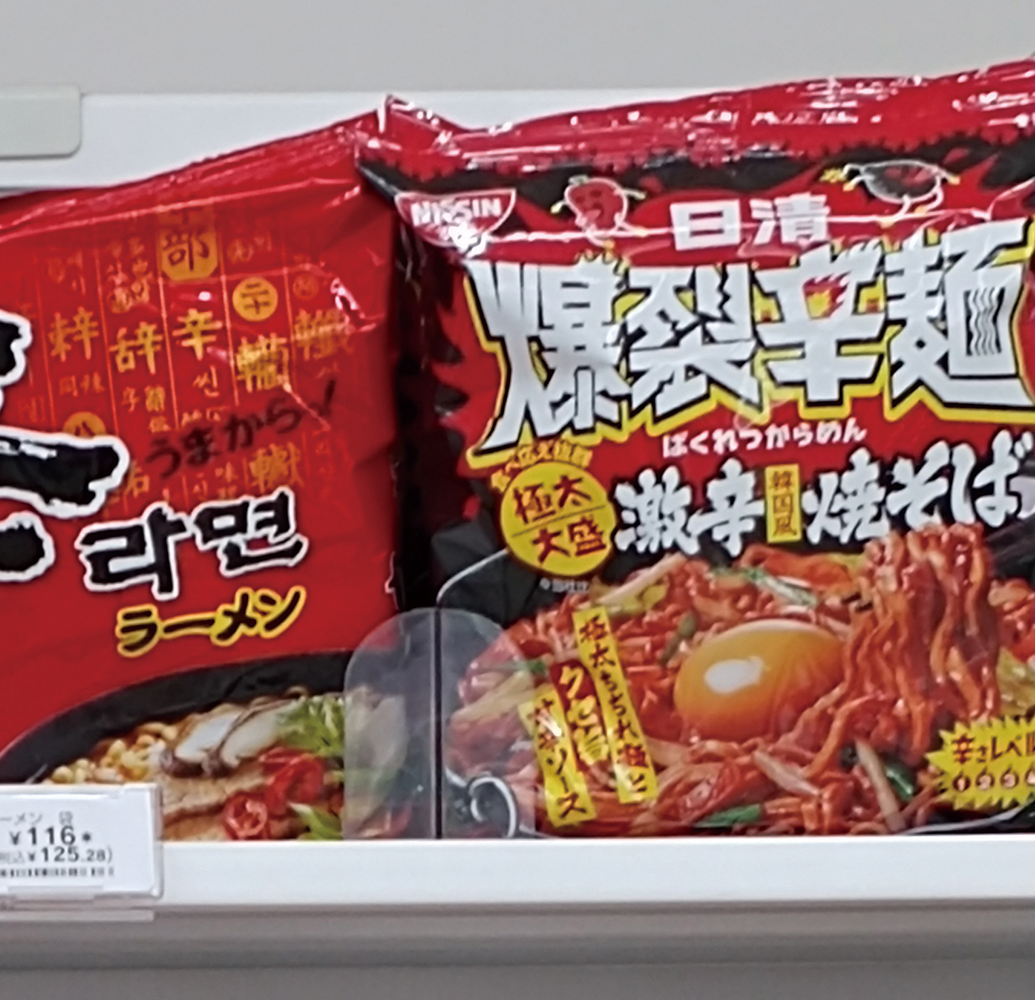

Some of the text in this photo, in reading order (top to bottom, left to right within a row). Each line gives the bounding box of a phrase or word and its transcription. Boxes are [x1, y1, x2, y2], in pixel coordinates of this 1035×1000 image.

[670, 192, 832, 250] 日清
[468, 217, 1034, 458] 爆裂辛麺
[662, 417, 868, 459] ばくれつからめん
[513, 475, 592, 525] 極太
[614, 455, 766, 557] 激辛
[801, 430, 1034, 546] 焼そば
[76, 488, 308, 600] 라면
[531, 513, 608, 564] 大盛
[115, 585, 308, 657] ラーメン
